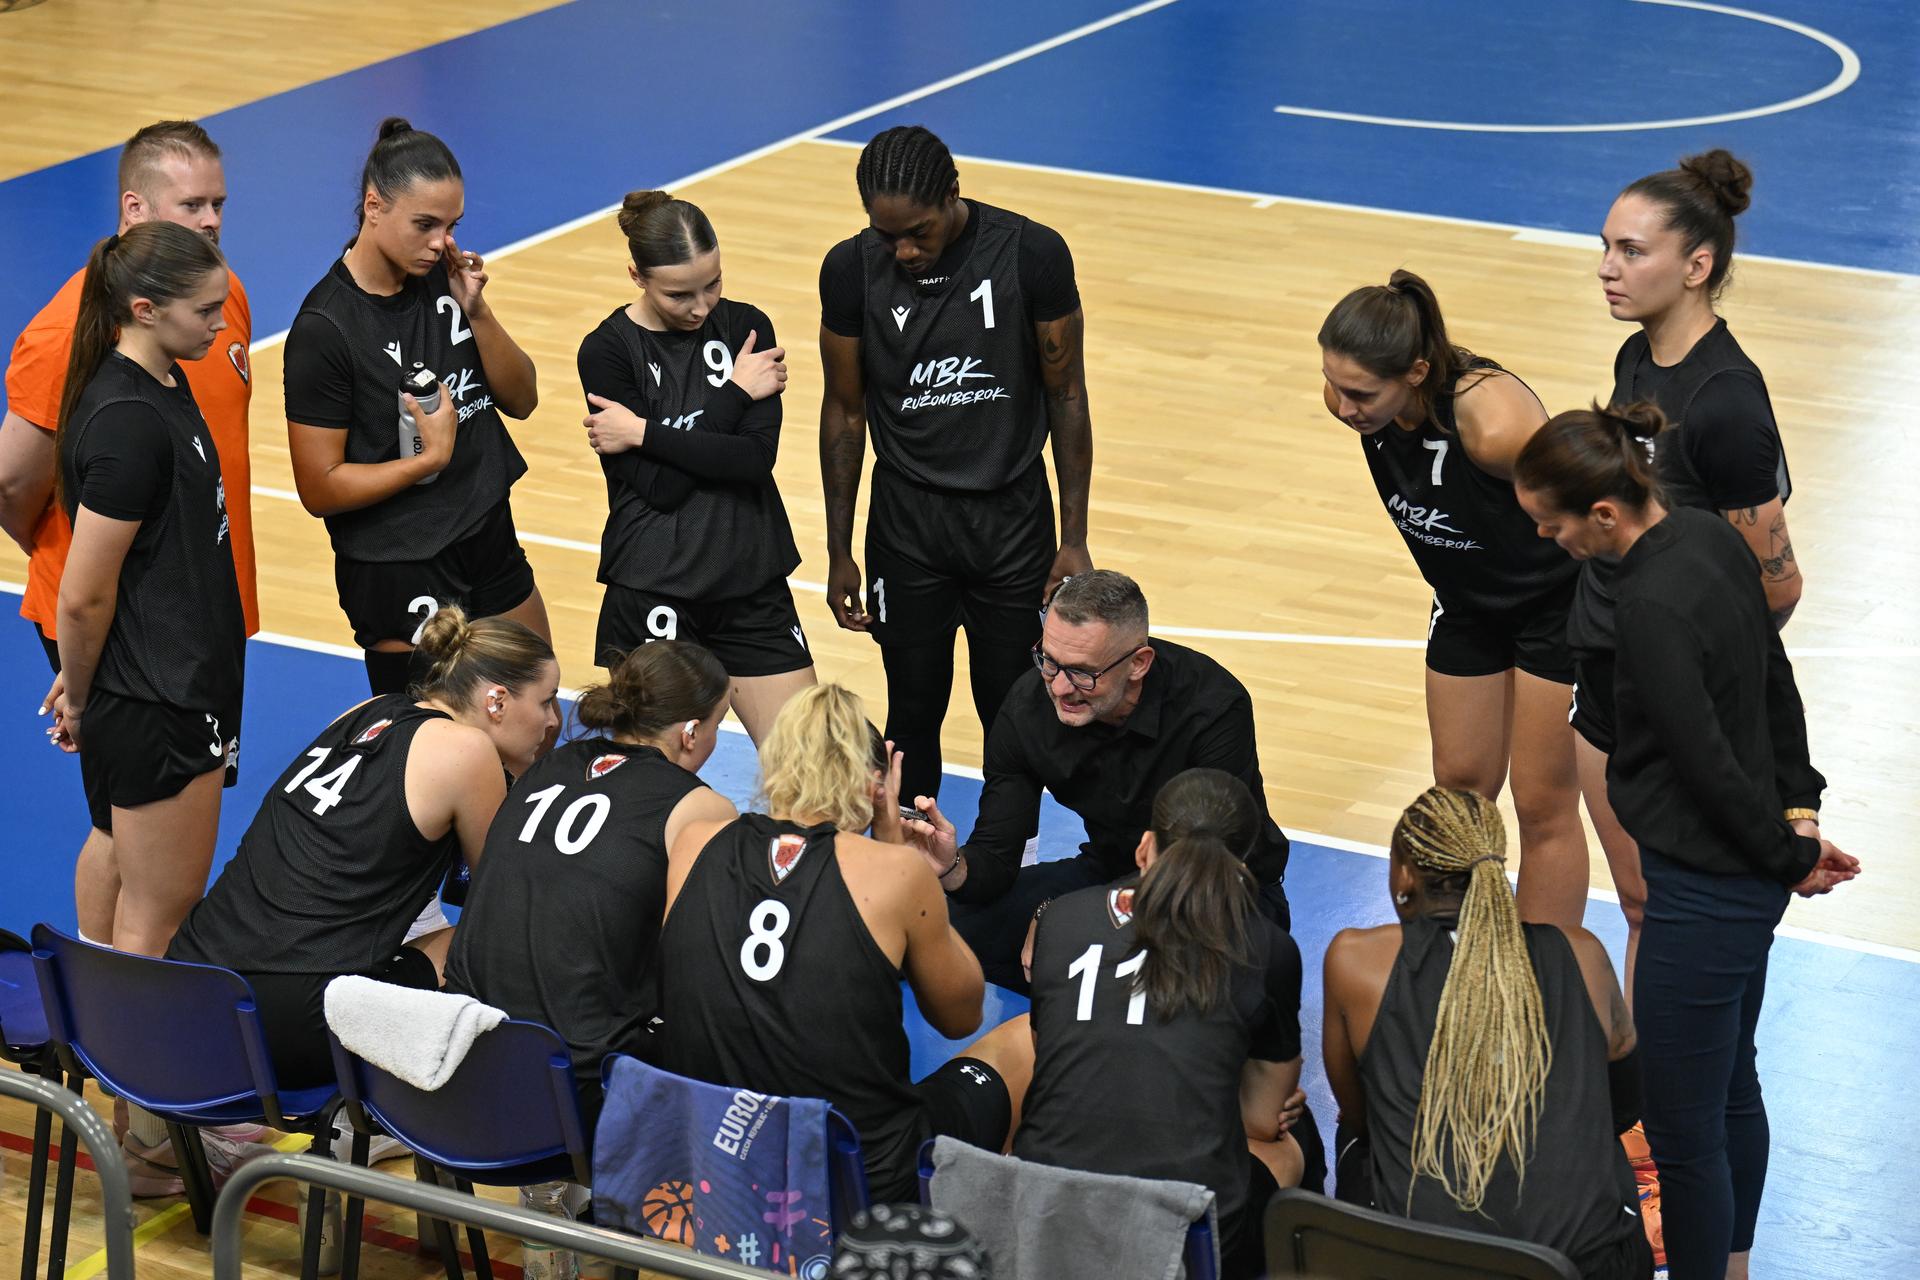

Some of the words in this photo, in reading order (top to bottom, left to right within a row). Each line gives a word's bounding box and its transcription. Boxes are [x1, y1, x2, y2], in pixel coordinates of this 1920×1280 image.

[436, 295, 473, 346] 2
[970, 279, 995, 329] 1
[442, 367, 482, 401] BK
[703, 340, 734, 388] 9
[909, 356, 996, 388] MBK
[901, 387, 1011, 412] RUŽOMBEROK
[413, 436, 422, 455] ron
[1422, 438, 1449, 486] 7
[1388, 493, 1464, 533] MBK
[408, 595, 439, 645] 2
[873, 577, 887, 623] 1
[646, 605, 678, 644] 9
[284, 746, 363, 817] 14
[518, 783, 611, 855] 10
[740, 899, 790, 982] 8
[1068, 944, 1148, 1025] 11
